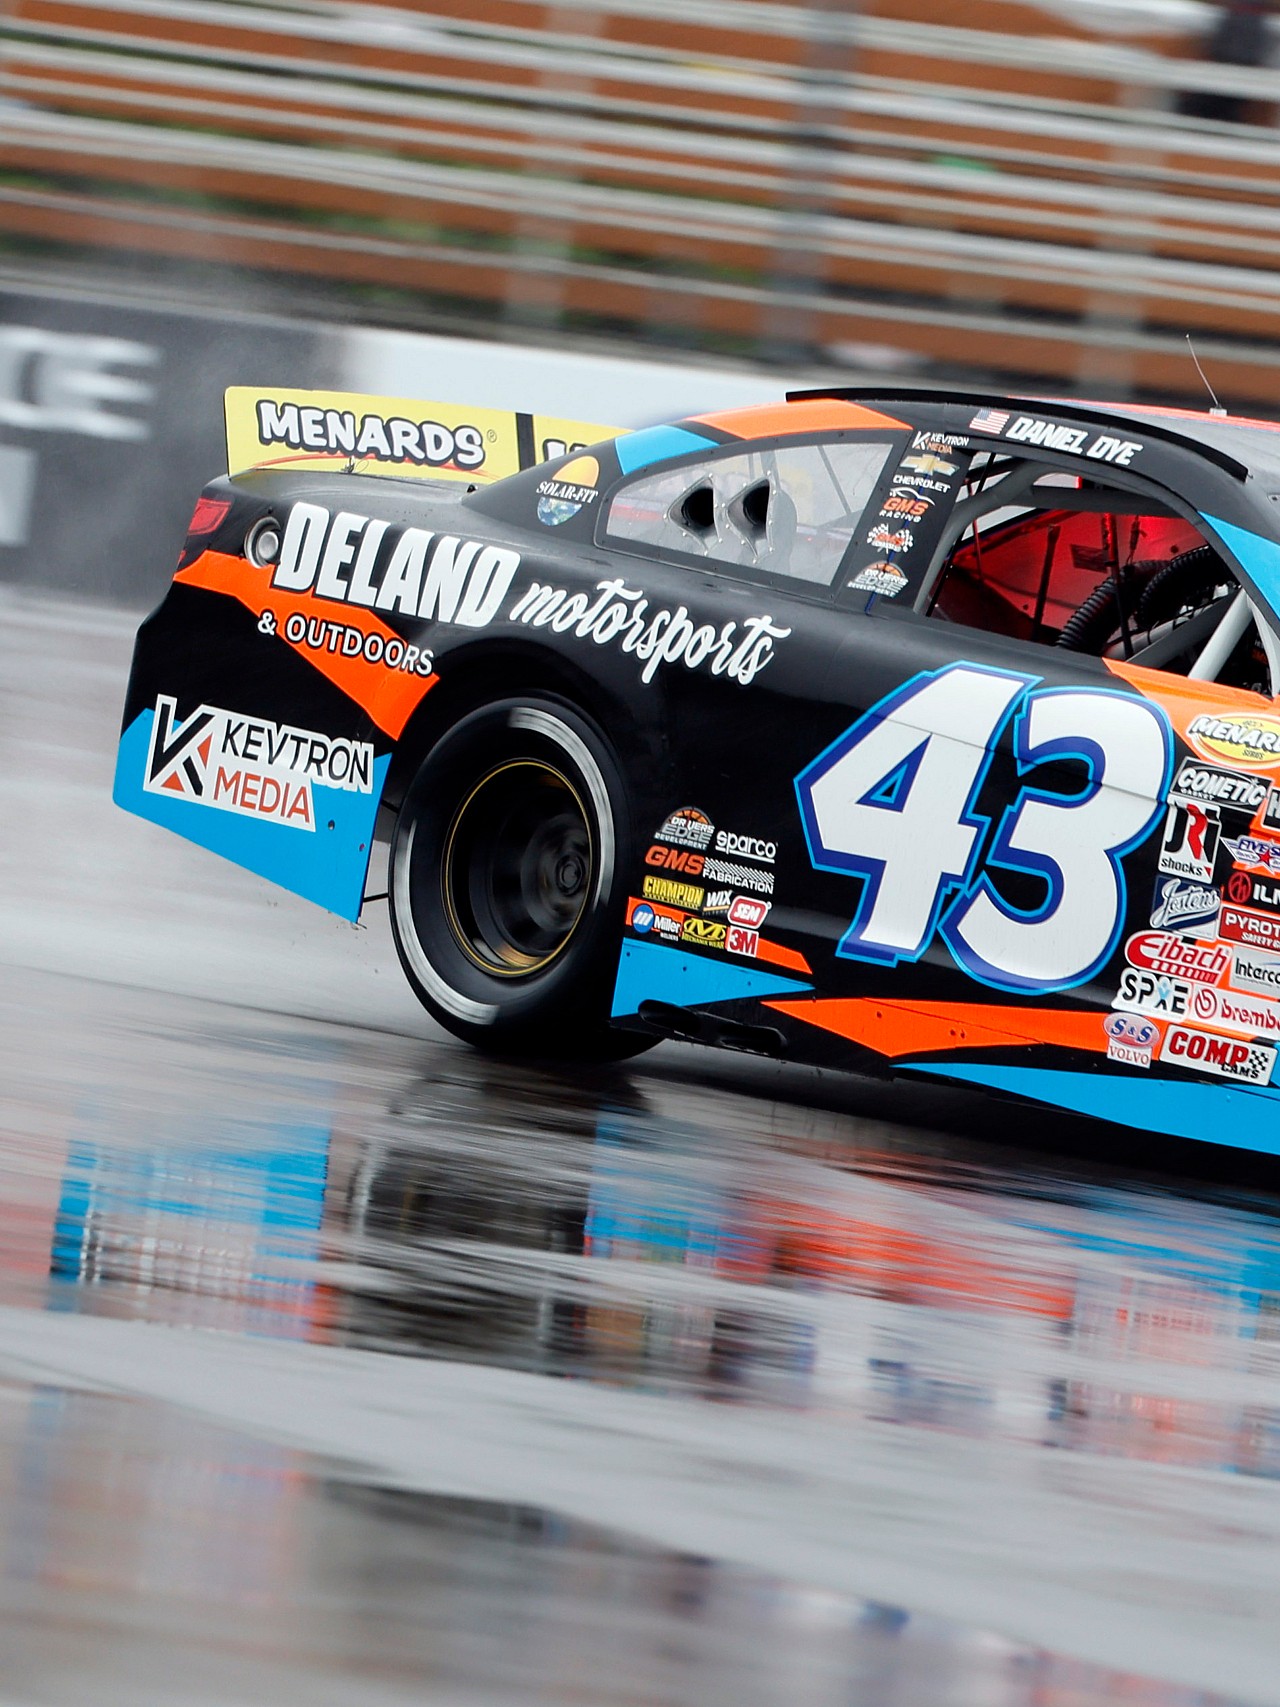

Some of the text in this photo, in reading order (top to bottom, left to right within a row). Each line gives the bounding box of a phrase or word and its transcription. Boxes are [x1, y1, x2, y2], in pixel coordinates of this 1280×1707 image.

[257, 399, 486, 470] MENARDS
[930, 432, 969, 447] KEVTRON
[1006, 416, 1143, 466] DANIEL DYE
[893, 474, 951, 493] CHEVROLET
[879, 510, 922, 523] RACING
[883, 497, 929, 516] GMS
[274, 502, 792, 686] DELAND motorsports
[257, 612, 434, 677] & OUTDOORS
[221, 718, 370, 786] KEVTRON
[213, 766, 311, 824] MEDIA
[1178, 768, 1266, 805] COMETIC
[661, 823, 714, 844] EDGE
[797, 663, 1172, 988] 43
[654, 832, 708, 850] DEVELOPMENT
[716, 830, 776, 858] sparco
[1238, 839, 1269, 853] FIVE
[645, 845, 705, 875] GMS
[1161, 858, 1202, 876] shocks
[644, 876, 704, 908] CHAMPION
[702, 868, 774, 895] FABRICATION
[706, 889, 733, 907] WIX
[1151, 878, 1220, 928] Jostens
[654, 915, 681, 934] Miller
[733, 902, 761, 923] SEM
[730, 928, 757, 956] 3M
[1127, 933, 1227, 971] Eibach
[1109, 1046, 1150, 1066] VOLVO
[1169, 1031, 1249, 1067] COMP
[1221, 1062, 1259, 1080] CAMS
